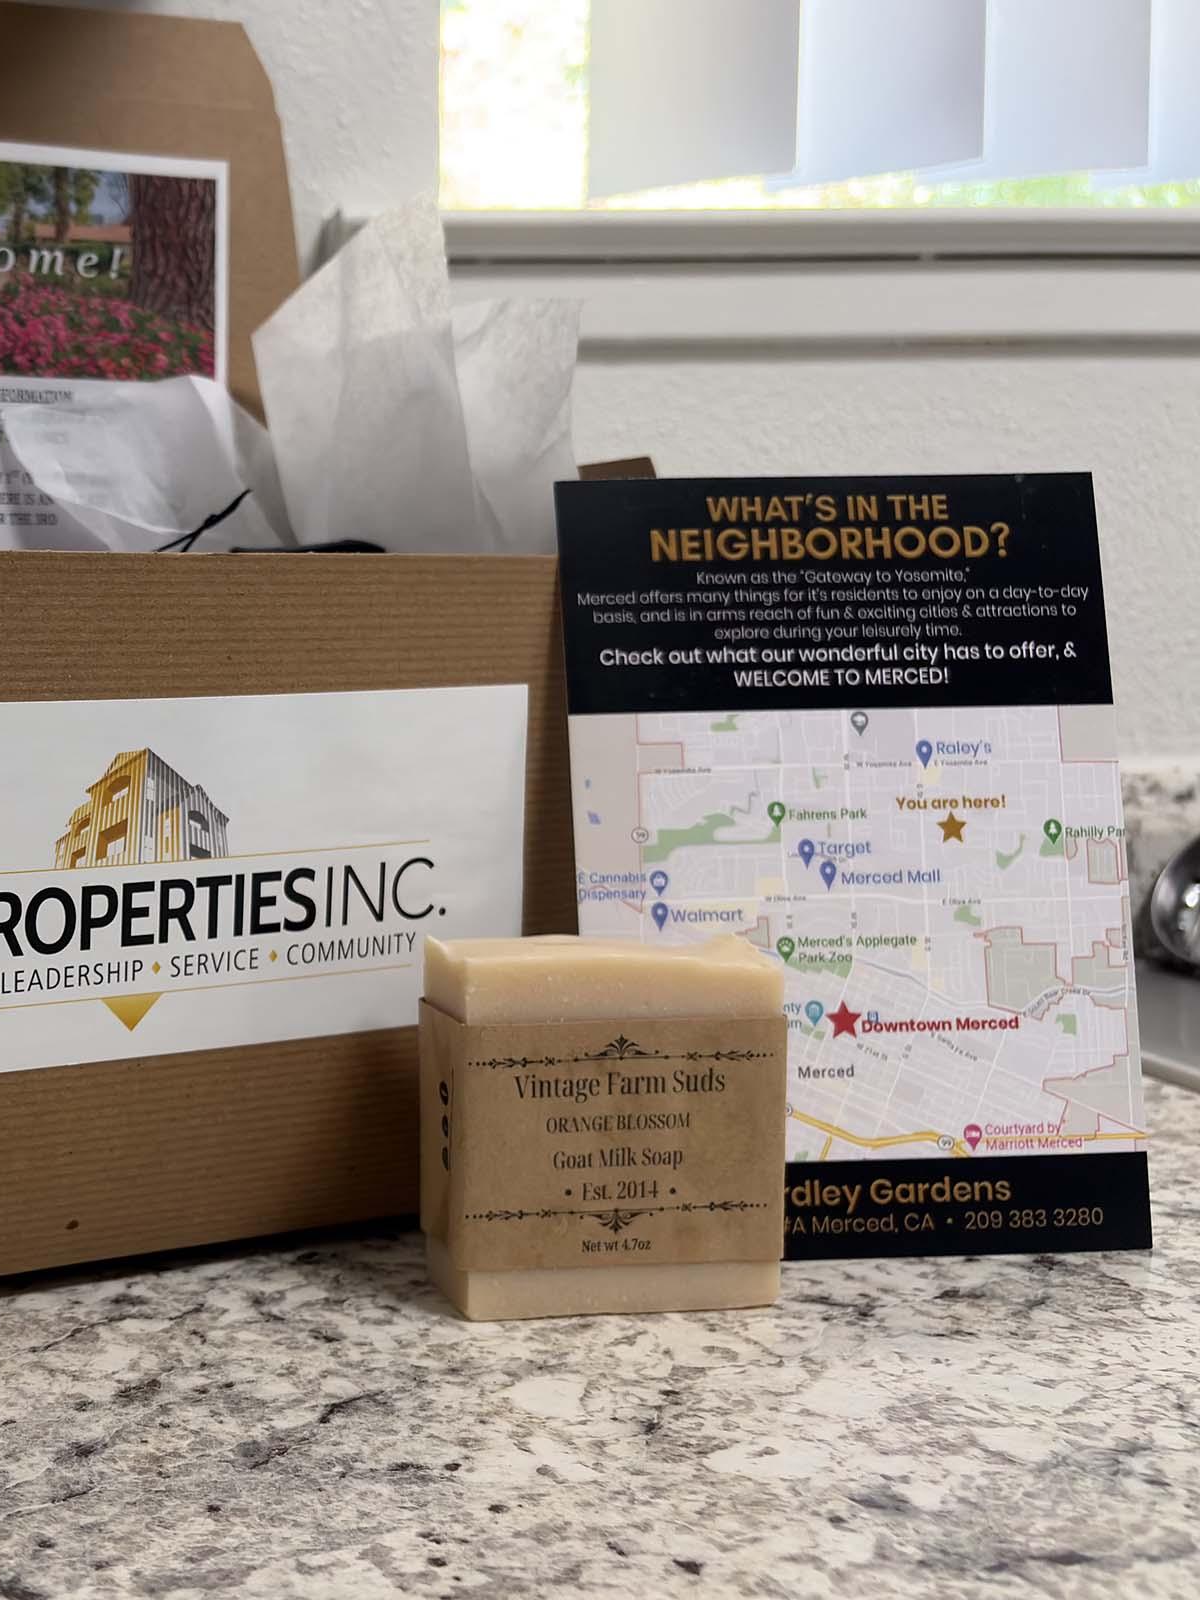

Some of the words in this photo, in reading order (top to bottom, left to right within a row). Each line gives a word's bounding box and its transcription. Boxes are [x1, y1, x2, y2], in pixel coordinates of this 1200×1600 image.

[706, 494, 837, 522] WHAT'S
[847, 495, 877, 522] IN
[887, 494, 948, 521] THE
[650, 523, 1009, 562] NEIGHBORHOOD?
[696, 571, 746, 585] Known
[751, 574, 768, 585] as
[772, 571, 797, 584] the
[876, 570, 891, 583] to
[577, 591, 636, 606] Merced
[734, 589, 780, 605] things
[784, 589, 805, 602] for
[831, 587, 899, 602] residents
[903, 588, 919, 600] to
[749, 608, 793, 621] reach
[858, 605, 916, 622] exciting
[976, 603, 1057, 617] attractions
[714, 627, 769, 643] explore
[773, 626, 821, 641] during
[600, 648, 663, 666] Check
[669, 648, 702, 665] out
[706, 647, 756, 664] what
[761, 650, 795, 663] our
[799, 644, 898, 663] wonderful
[903, 643, 937, 665] city
[943, 643, 979, 661] has
[984, 644, 1003, 660] to
[1008, 641, 1059, 662] offer,
[1064, 642, 1076, 658] &
[734, 668, 830, 687] WELCOME
[834, 668, 859, 686] TO
[865, 666, 950, 685] MERCED!
[936, 740, 992, 758] Raley's
[896, 797, 927, 811] You
[932, 799, 958, 810] are
[962, 794, 1007, 809] here!
[789, 809, 837, 822] Fahrens
[841, 808, 867, 820] Park
[1065, 825, 1104, 840] Rahilly
[817, 841, 871, 857] Target
[590, 872, 646, 884] Cannabis
[841, 870, 902, 886] Merced
[908, 870, 940, 884] Mall
[579, 889, 646, 901] Dispensary
[671, 909, 743, 923] Walmart
[798, 936, 852, 948] Merced's
[856, 935, 916, 950] Applegate
[0, 960, 143, 995] LEADERSHIP
[170, 948, 259, 978] SERVICE
[286, 932, 416, 967] COMMUNITY
[827, 952, 852, 964] Zoo
[862, 1020, 951, 1033] Downtown
[956, 1016, 1019, 1031] Merced
[798, 1065, 855, 1080] Merced
[513, 1074, 600, 1103] Vintage
[607, 1072, 665, 1096] Farm
[673, 1067, 725, 1094] Suds
[546, 1116, 612, 1134] ORANGE
[617, 1112, 690, 1131] BLOSSOM
[986, 1122, 1043, 1137] Courtyard
[1048, 1121, 1060, 1136] by
[987, 1139, 1033, 1151] Marriott
[553, 1150, 593, 1169] Goat
[599, 1147, 637, 1168] Milk
[642, 1147, 683, 1170] Soap
[582, 1181, 612, 1200] Est.
[870, 1176, 1011, 1206] Gardens
[812, 1213, 898, 1233] Merced,
[905, 1212, 934, 1230] CA
[965, 1211, 1003, 1229] 209
[1009, 1210, 1046, 1228] 383
[1054, 1207, 1104, 1226] 3280
[581, 1240, 601, 1253] Net
[605, 1241, 618, 1252] wt
